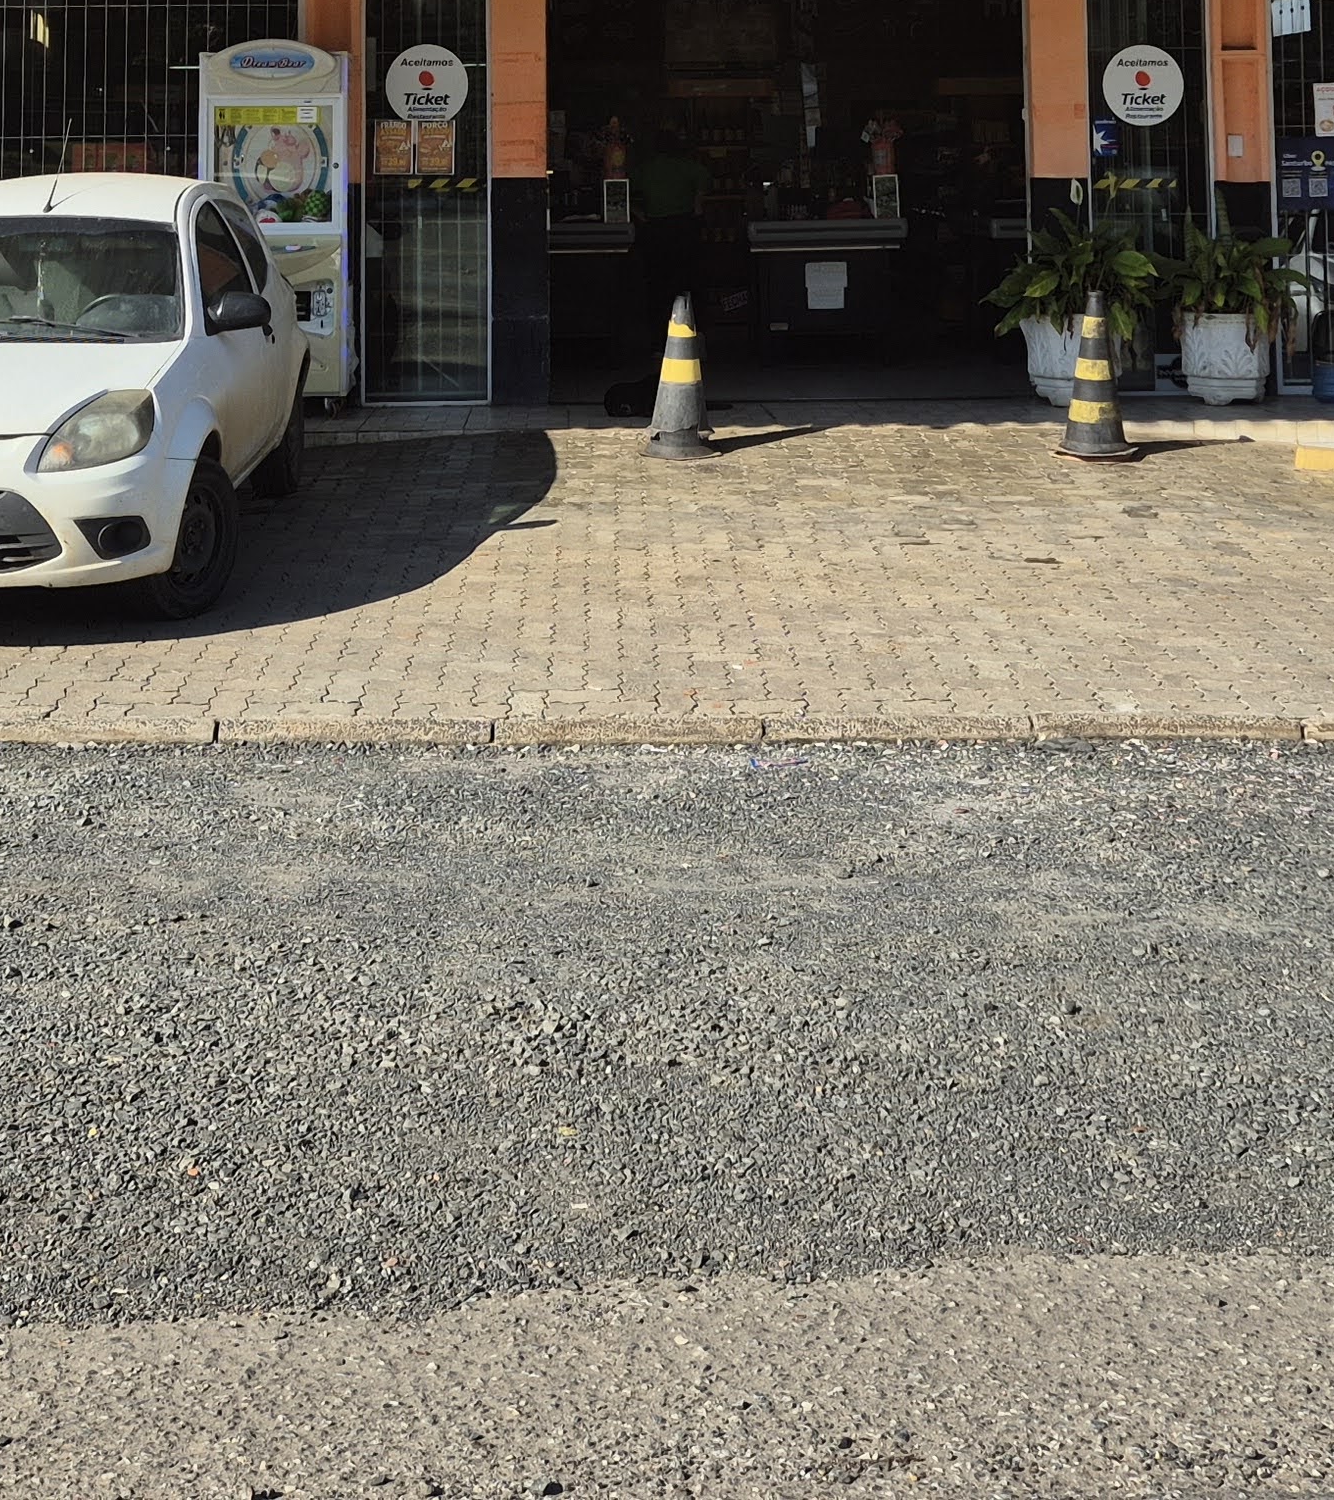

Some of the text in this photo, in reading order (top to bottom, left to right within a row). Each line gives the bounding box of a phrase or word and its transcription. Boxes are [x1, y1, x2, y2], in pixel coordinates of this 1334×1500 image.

[400, 58, 454, 67] Aceitamos
[1117, 59, 1169, 68] Aceitamos
[404, 92, 451, 106] Ticket
[1121, 92, 1167, 106] Ticket
